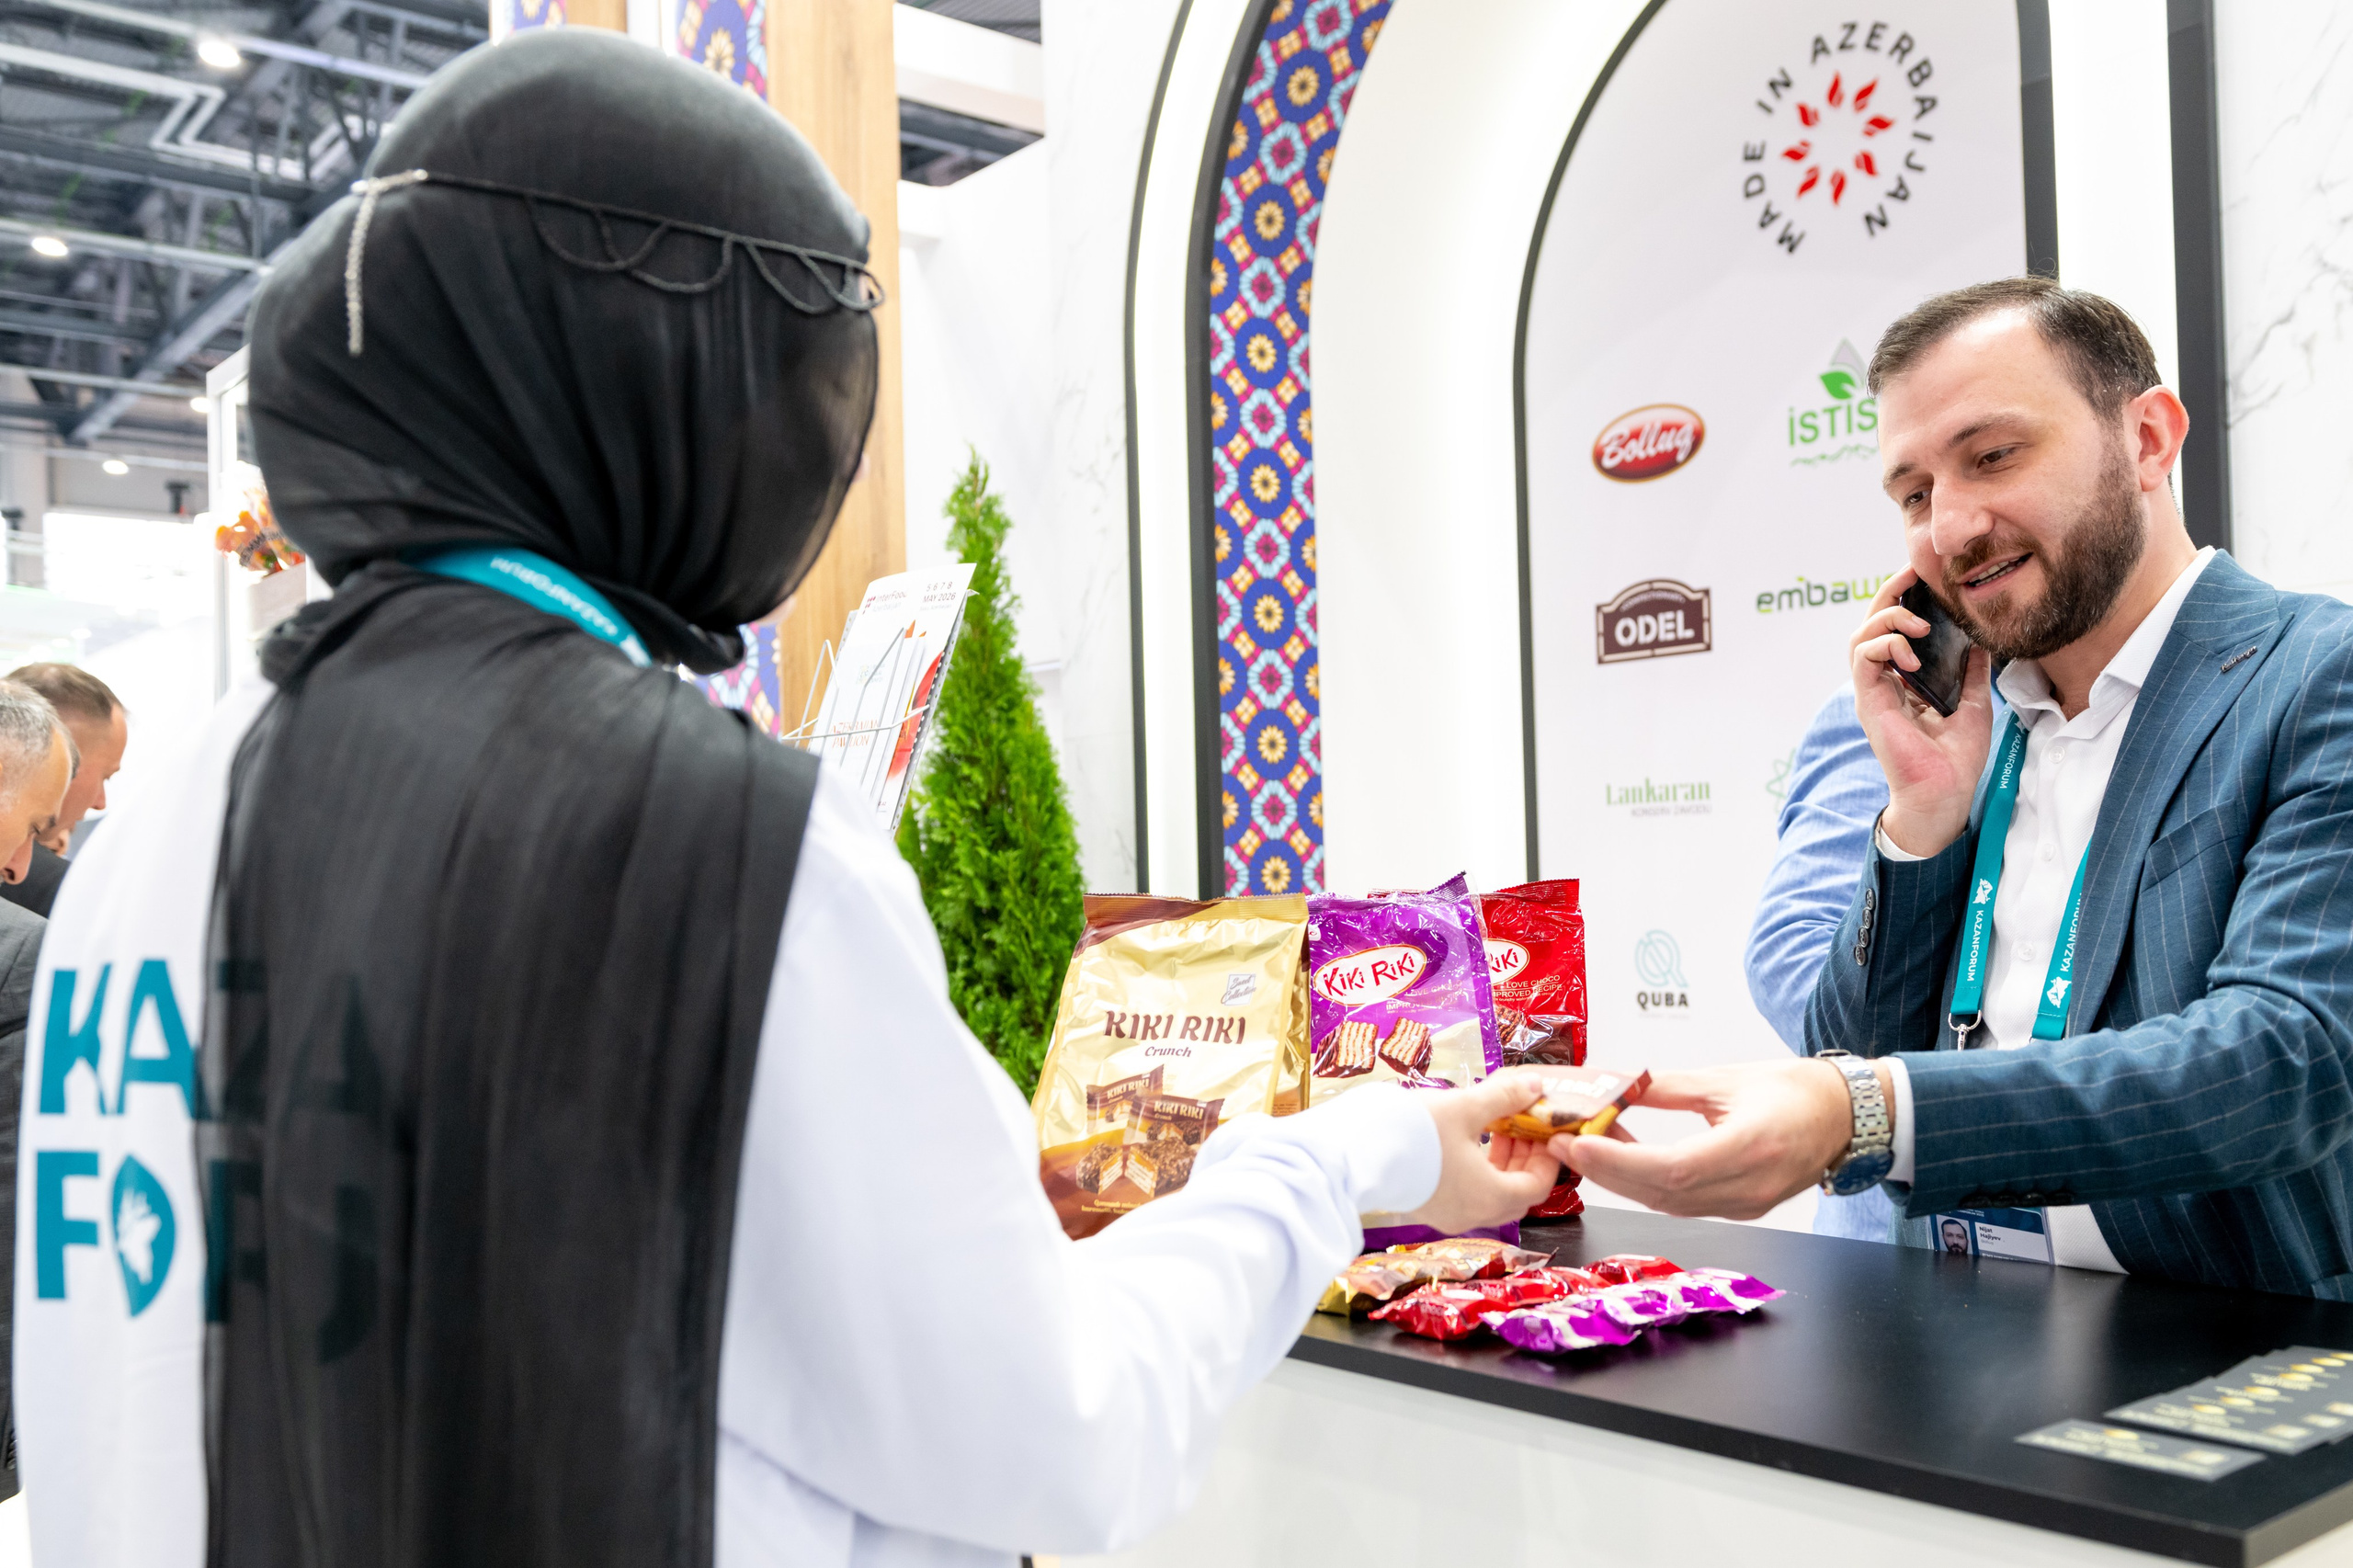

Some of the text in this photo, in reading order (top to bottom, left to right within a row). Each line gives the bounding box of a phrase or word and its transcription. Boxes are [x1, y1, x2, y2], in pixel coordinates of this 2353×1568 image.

[1743, 21, 1938, 254] MADE IN AZERBAIJAN
[923, 592, 956, 603] MAY 2026
[1756, 573, 1897, 613] embaw
[1614, 609, 1695, 647] ODEL
[1999, 733, 2022, 789] KAZANFORUM
[1605, 777, 1711, 806] Lankaran
[1966, 910, 1984, 982] KAZANFORUM
[2060, 892, 2082, 972] KAZANFOR
[1493, 990, 1530, 998] PROVED
[1506, 974, 1560, 989] LOVE CHOCO
[1637, 992, 1688, 1011] QUBA
[1104, 1010, 1245, 1044] KIKI RIKI
[1144, 1046, 1191, 1057] Crunch
[1107, 1084, 1127, 1099] KIKI
[1129, 1078, 1150, 1092] RIKI
[1154, 1101, 1204, 1119] KIKI RIKI
